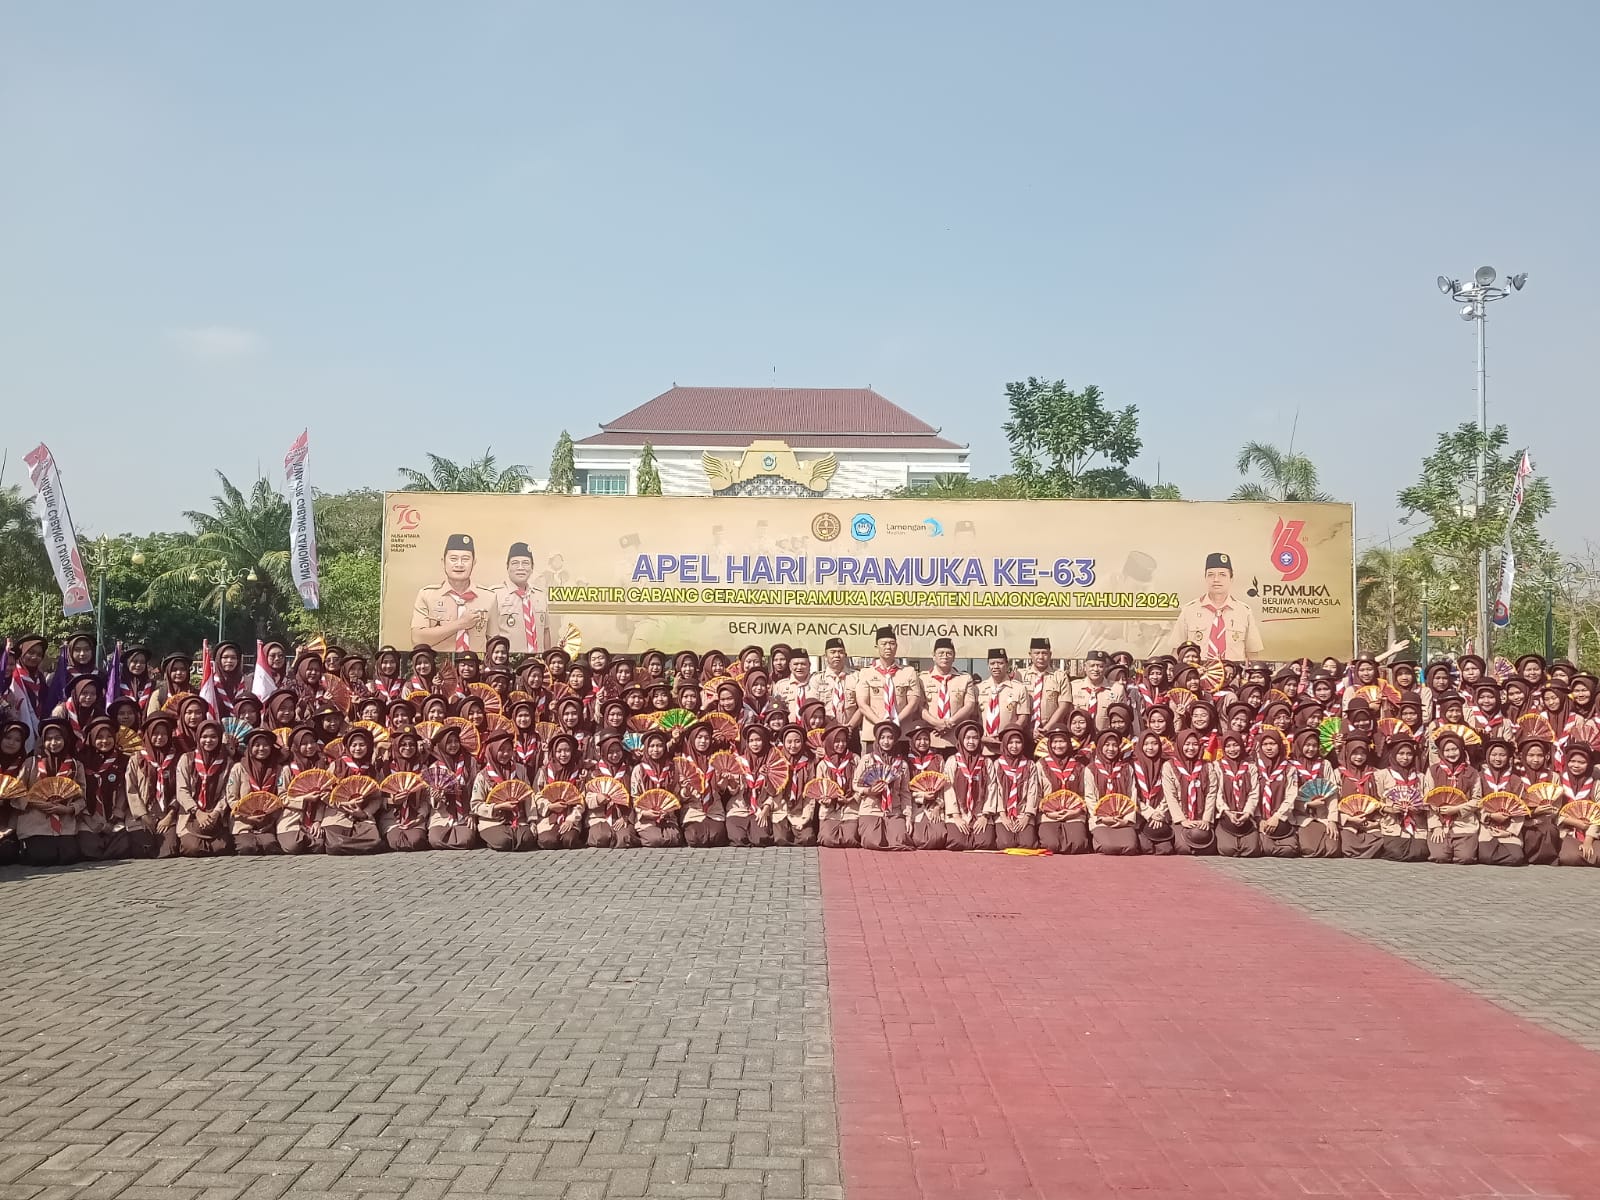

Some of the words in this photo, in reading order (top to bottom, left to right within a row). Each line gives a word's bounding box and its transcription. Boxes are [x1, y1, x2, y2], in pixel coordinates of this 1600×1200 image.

[632, 553, 720, 583] APEL
[726, 555, 806, 585] HARI
[815, 556, 987, 587] PRAMUKA
[993, 557, 1095, 587] KE-63
[549, 586, 625, 602] KWARTIR
[627, 587, 699, 603] CABANG
[701, 588, 782, 605] GERAKAN
[784, 589, 868, 606] PRAMUKA
[870, 590, 970, 607] KABUPATEN
[973, 591, 1071, 607] LAMONGAN
[1073, 592, 1133, 608] TAHUN
[1136, 593, 1180, 609] 2024
[1263, 584, 1330, 597] PRAMUKA
[1262, 597, 1295, 605] BERJIWA
[1297, 598, 1341, 607] PANCASILA
[1262, 606, 1299, 614] MENJAGA
[1301, 607, 1320, 615] NKRI
[728, 621, 792, 636] BERJIWA
[797, 622, 878, 636] PANCASILA
[963, 624, 998, 638] NKRI
